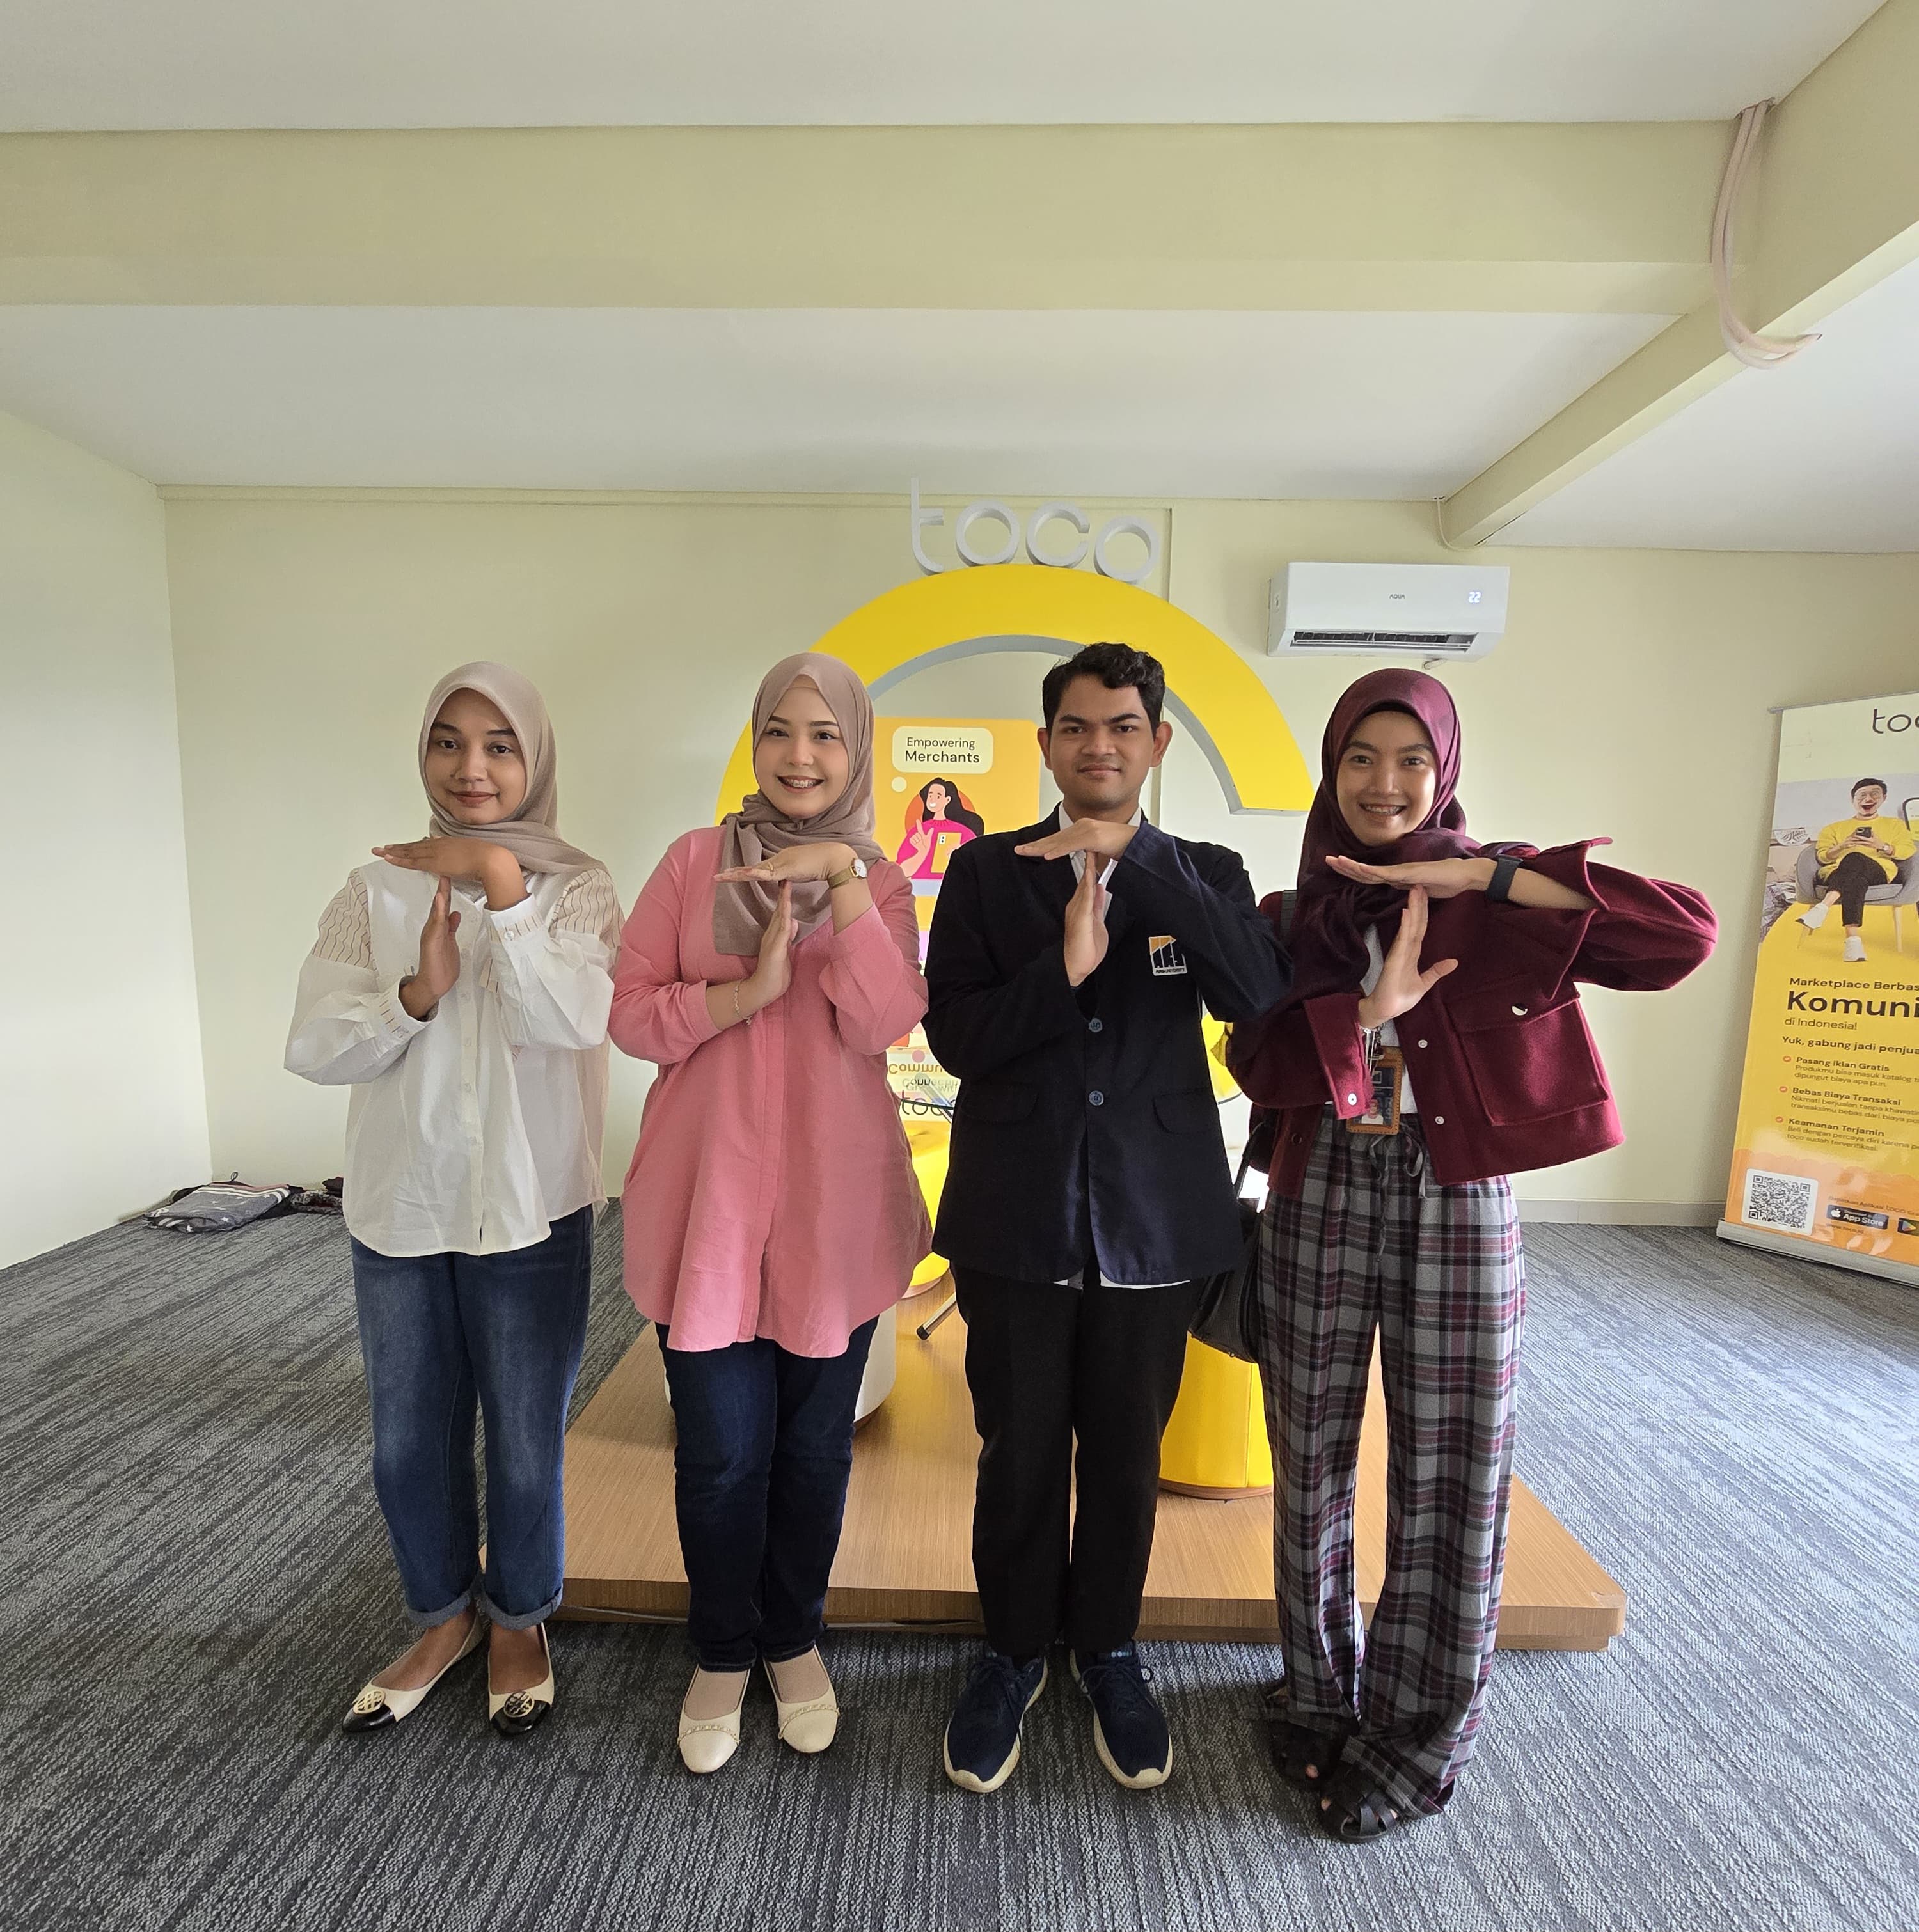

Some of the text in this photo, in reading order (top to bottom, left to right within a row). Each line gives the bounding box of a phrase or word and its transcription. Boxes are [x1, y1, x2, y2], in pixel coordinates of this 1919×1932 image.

[910, 477, 1160, 583] toco
[1468, 592, 1481, 603] 22
[1873, 709, 1919, 734] to
[907, 737, 975, 750] Empowering
[905, 750, 980, 763] Merchants
[1789, 978, 1870, 989] Marketplace
[1787, 990, 1919, 1018] Komuni
[1798, 1018, 1858, 1030] Indonesia!
[1782, 1036, 1804, 1046] Yuk,
[1808, 1039, 1851, 1050] gabung
[1854, 1042, 1876, 1051] jadi
[1796, 1057, 1890, 1071] Pasang Iklan Gratis
[1794, 1072, 1829, 1081] dipungut
[1795, 1065, 1835, 1074] Produkmu
[1882, 1074, 1912, 1083] katalog
[1791, 1095, 1820, 1104] Nikmati
[1822, 1099, 1858, 1108] berjualan
[1792, 1087, 1901, 1105] Bebas Biaya Transaksi
[1791, 1103, 1837, 1113] transaksimu
[1883, 1114, 1905, 1122] biaya
[1789, 1118, 1884, 1136] Keamanan Terjamin
[1833, 1133, 1865, 1142] percaya
[1886, 1204, 1906, 1214] toco
[1843, 1214, 1884, 1227] App Store
